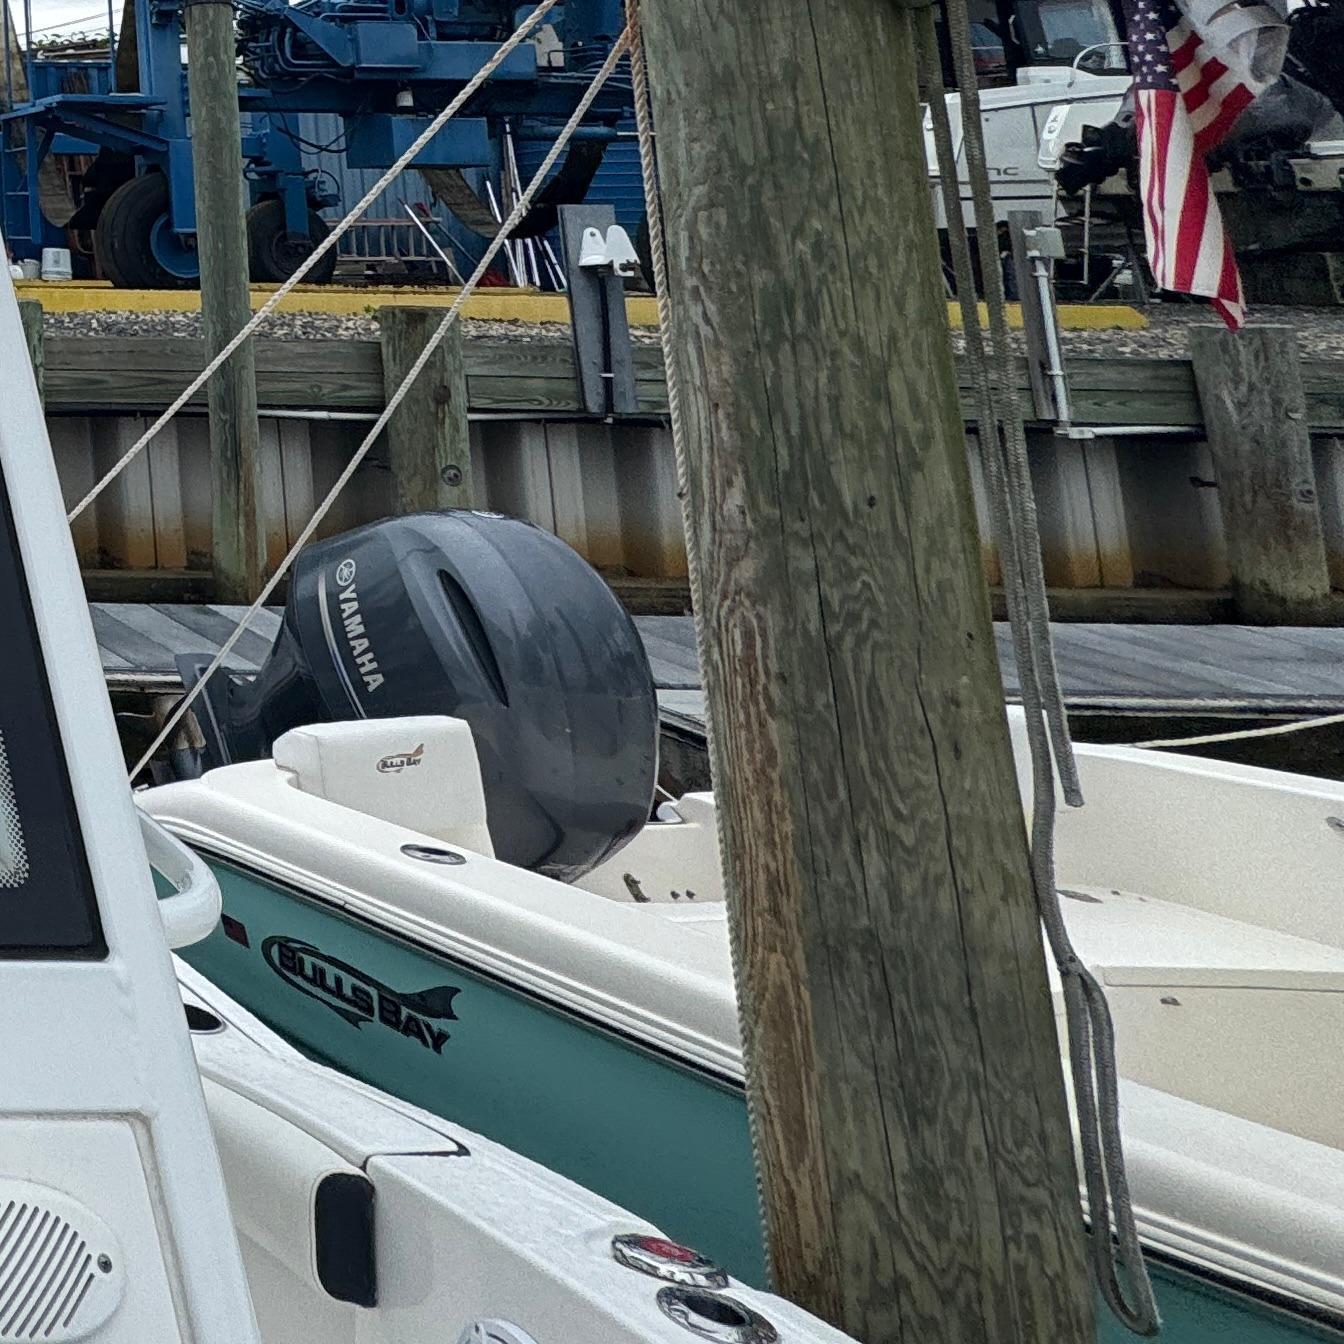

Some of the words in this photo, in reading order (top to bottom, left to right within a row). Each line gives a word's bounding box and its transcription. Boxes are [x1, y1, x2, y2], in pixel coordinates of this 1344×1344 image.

[338, 583, 385, 693] YAMAHA
[277, 942, 375, 1018] BULLS
[378, 990, 451, 1055] BAY
